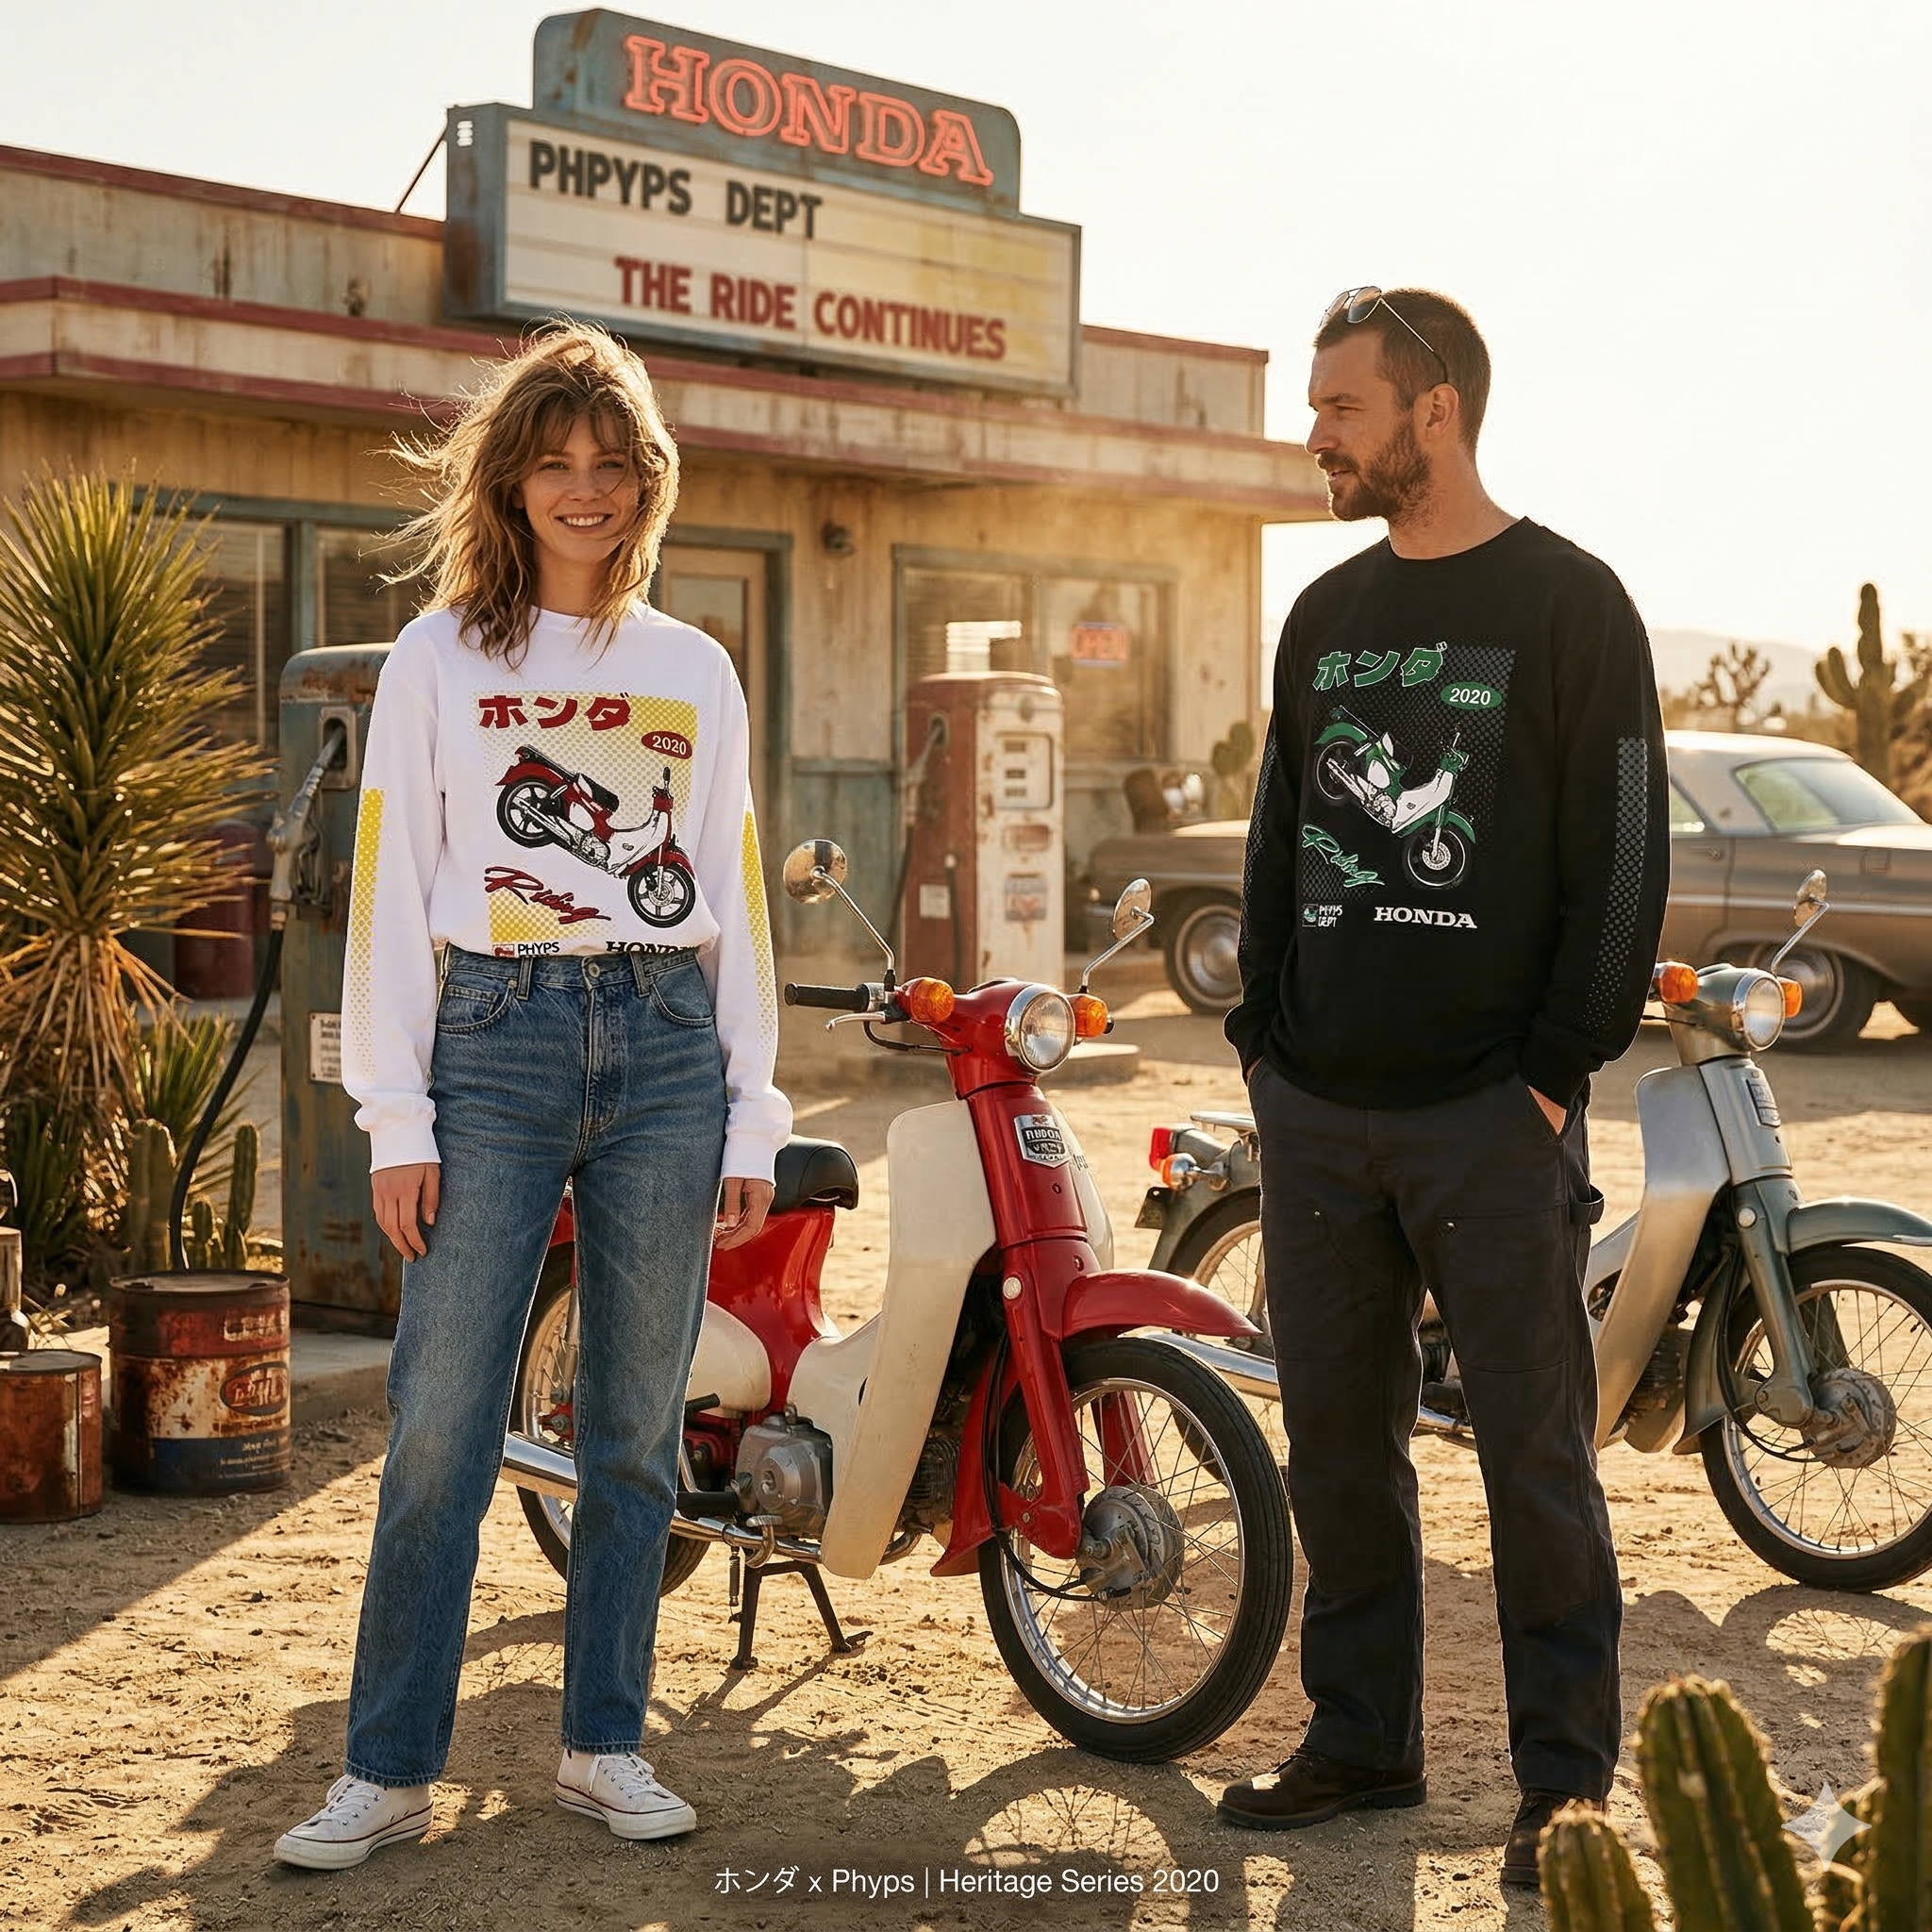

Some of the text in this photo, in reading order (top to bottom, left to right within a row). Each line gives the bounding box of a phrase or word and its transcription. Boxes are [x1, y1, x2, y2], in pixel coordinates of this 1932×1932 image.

[624, 35, 994, 186] HONDA
[528, 139, 824, 240] PHPYPS DEPT
[614, 256, 1008, 361] THE RIDE CONTINUES
[1312, 641, 1447, 691] ホンダ
[478, 691, 633, 731] ホンダ
[1449, 688, 1491, 707] 2020
[652, 735, 688, 757] 2020
[1374, 907, 1478, 929] HONDA
[518, 941, 560, 956] PHYPS
